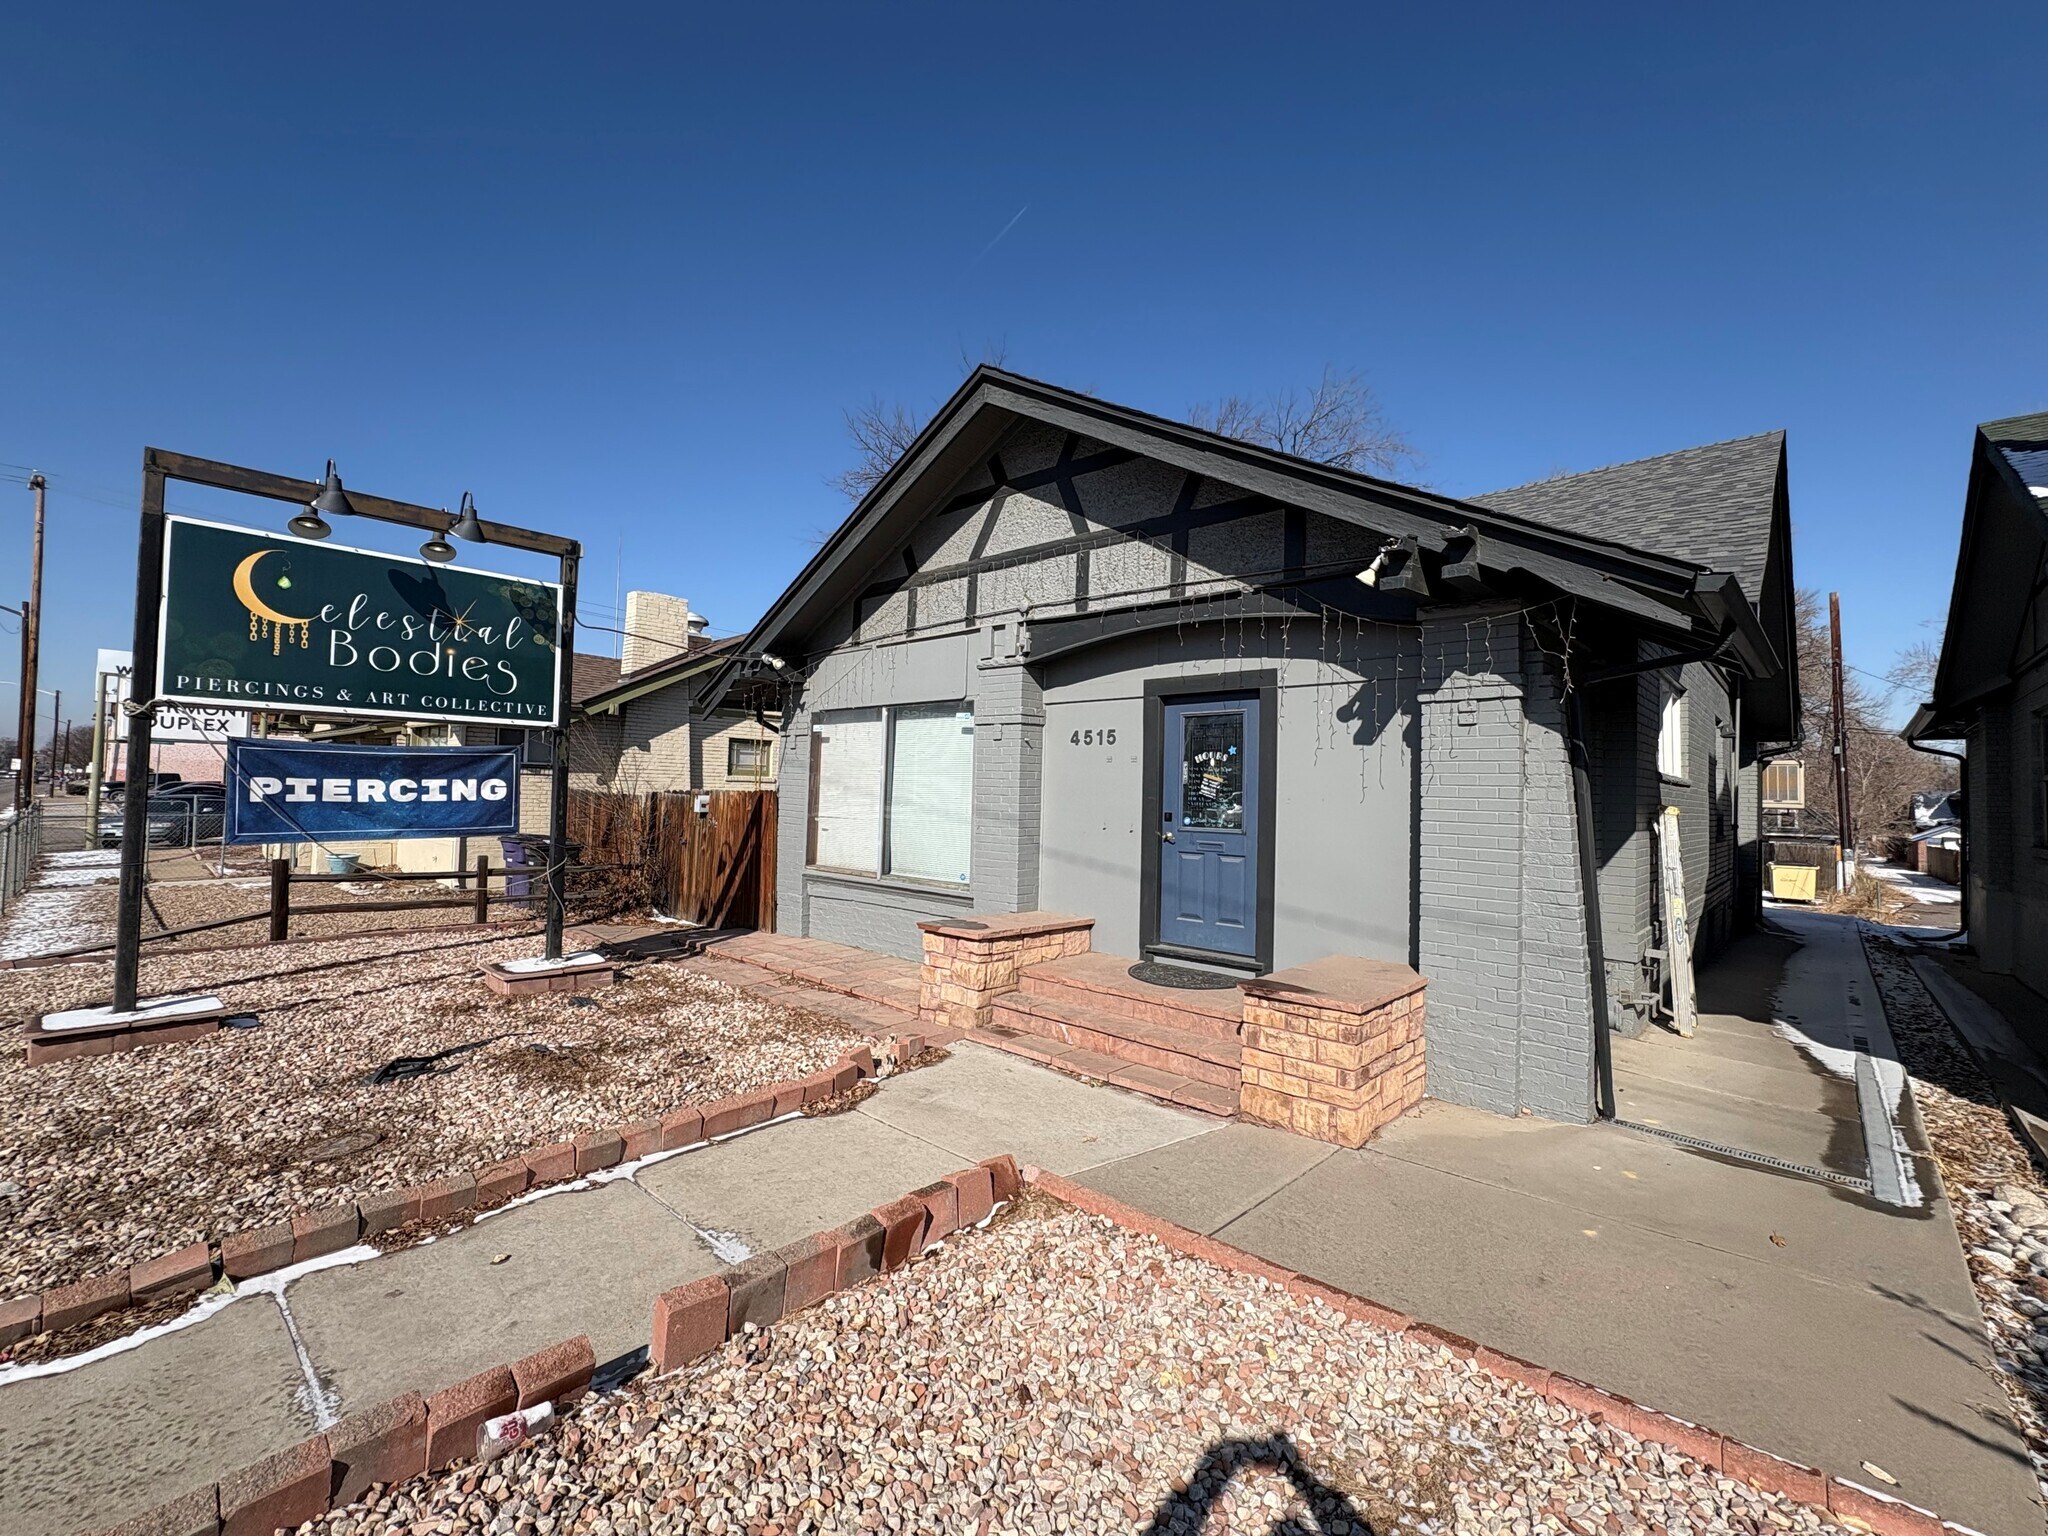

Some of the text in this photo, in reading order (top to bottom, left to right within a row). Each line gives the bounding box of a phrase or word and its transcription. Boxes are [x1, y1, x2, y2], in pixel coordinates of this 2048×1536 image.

[329, 629, 518, 696] Bodies
[176, 675, 548, 716] PIERCINGS & ART COLLECTIVE
[1070, 728, 1117, 746] 4515
[1194, 751, 1229, 764] HOURS
[249, 776, 508, 803] PIERCING
